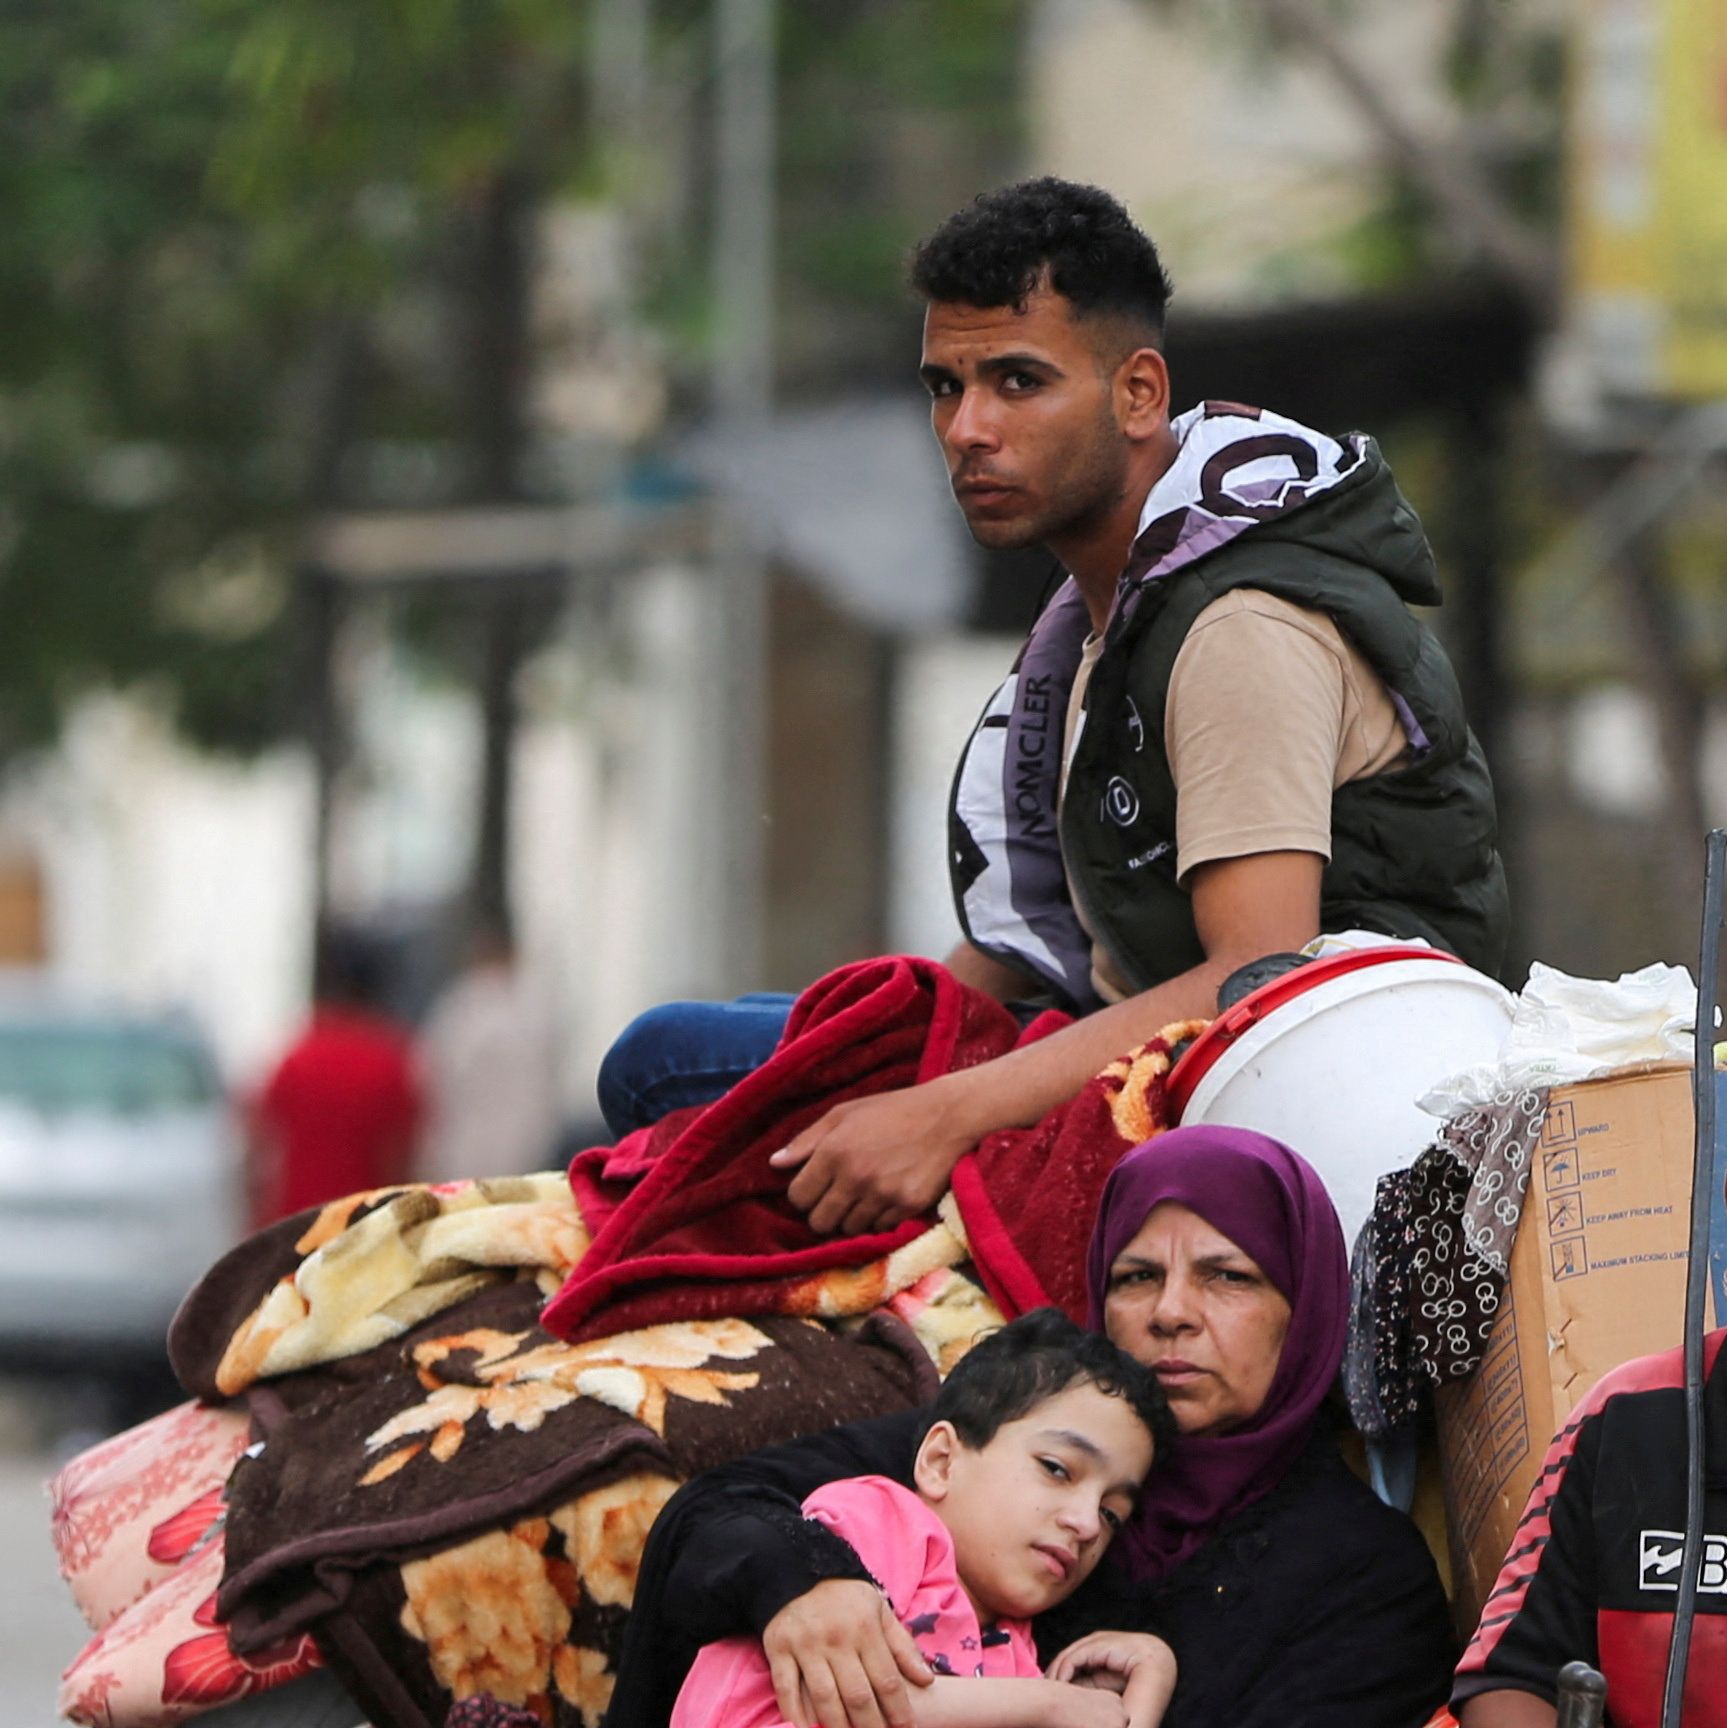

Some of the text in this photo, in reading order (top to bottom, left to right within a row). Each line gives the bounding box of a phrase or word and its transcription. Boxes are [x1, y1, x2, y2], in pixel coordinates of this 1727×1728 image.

[1015, 674, 1057, 838] NOMCLER
[1578, 1123, 1610, 1137] UPWARD
[1582, 1168, 1617, 1182] KEEP DRY
[1586, 1205, 1673, 1225] KEEP AWAY FROM HEAT
[1591, 1258, 1628, 1270] MAXIMUM
[1629, 1254, 1669, 1265] STACKING
